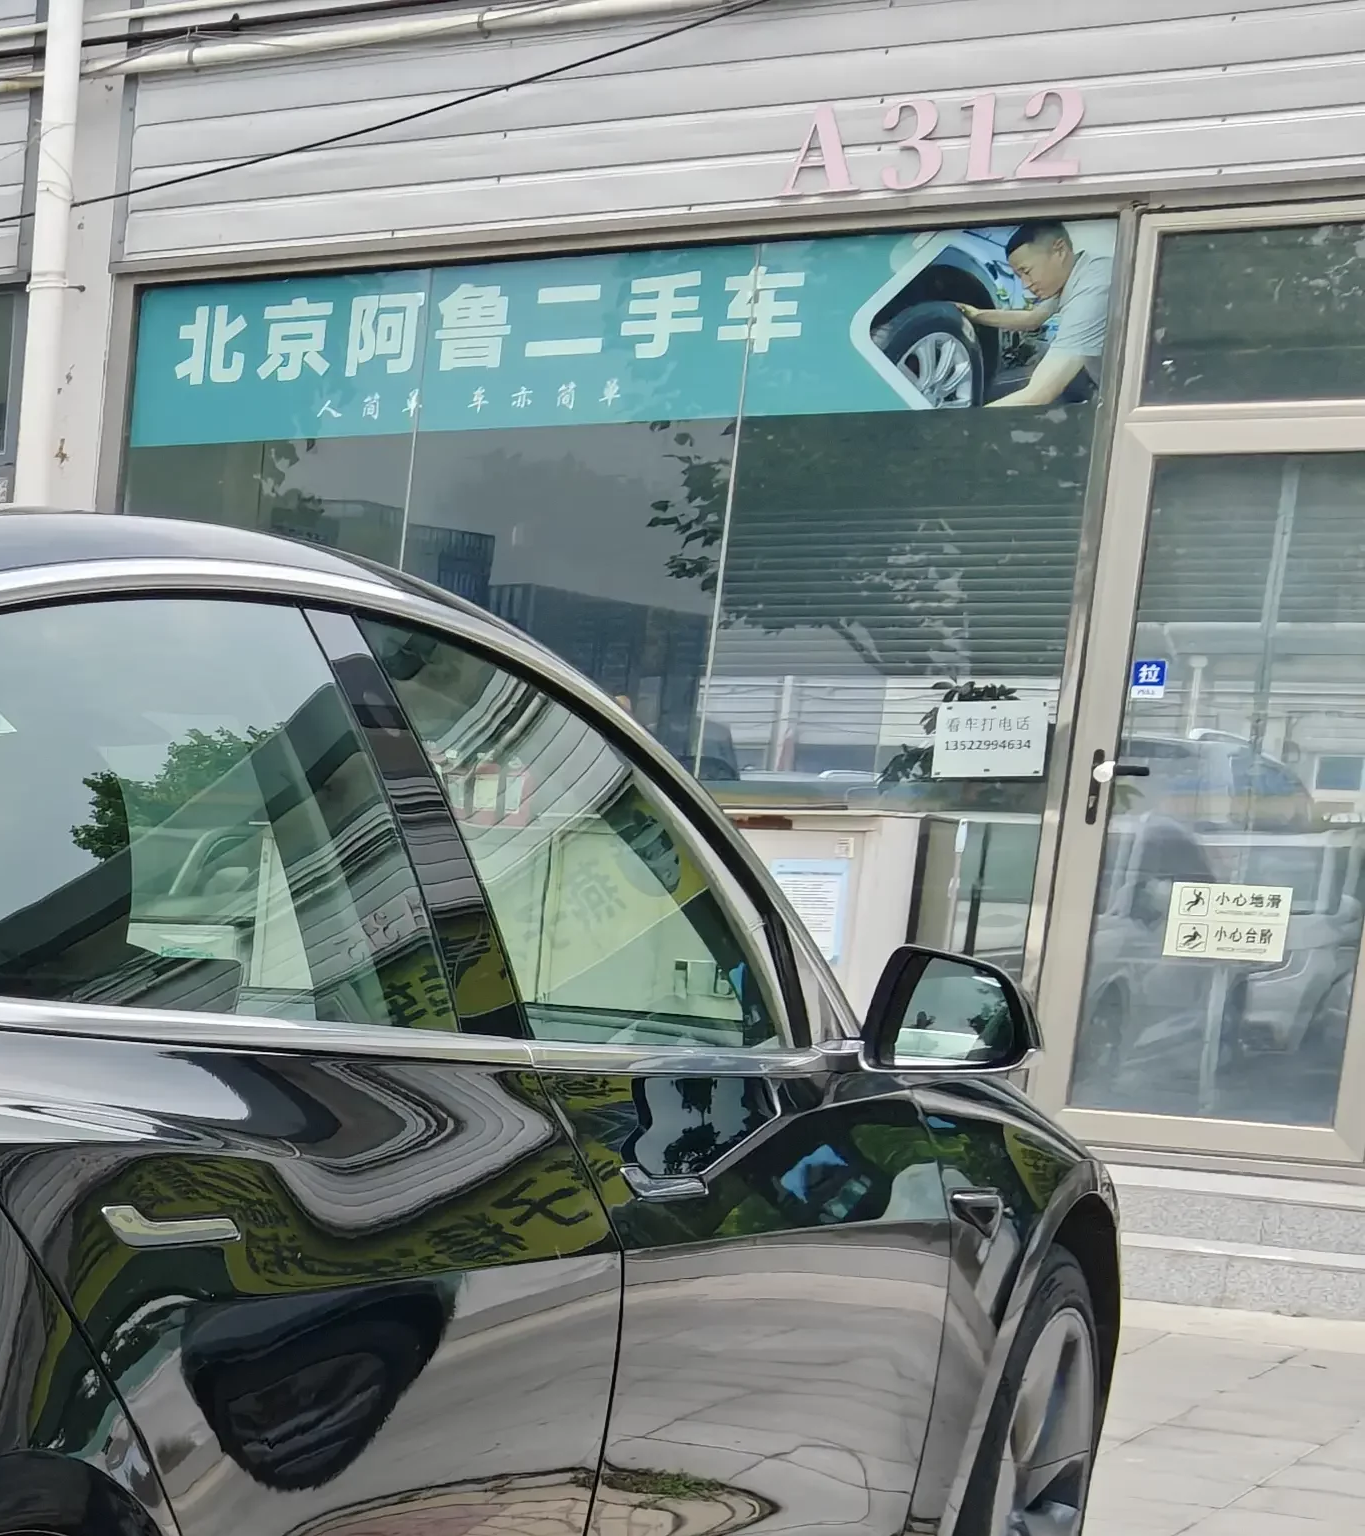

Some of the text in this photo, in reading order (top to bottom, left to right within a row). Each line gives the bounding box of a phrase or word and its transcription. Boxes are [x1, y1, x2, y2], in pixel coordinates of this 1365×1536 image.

[778, 86, 1085, 196] A312
[174, 266, 806, 385] 北京阿鲁二手车
[1138, 663, 1161, 683] 拉
[946, 716, 1032, 732] 看车打电话
[945, 739, 1031, 751] 13522994634
[1215, 891, 1282, 909] 小心地滑
[1213, 925, 1273, 945] 小心台阶
